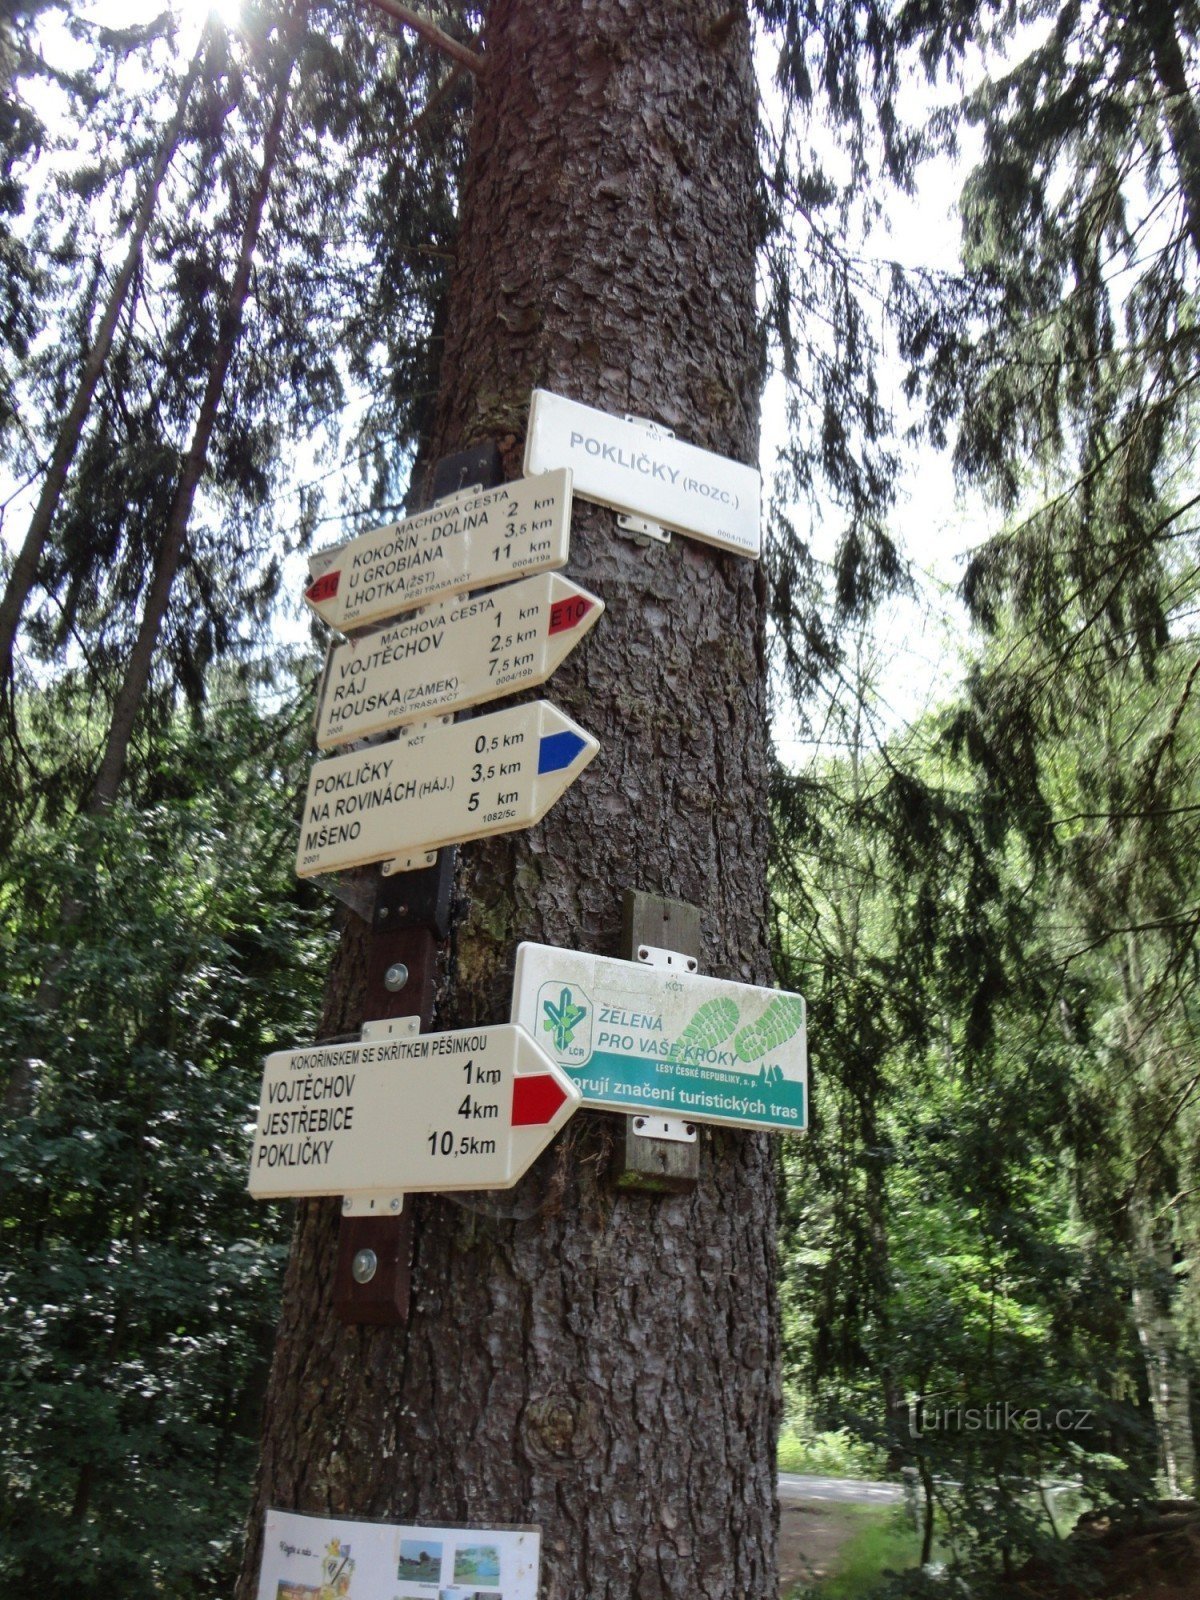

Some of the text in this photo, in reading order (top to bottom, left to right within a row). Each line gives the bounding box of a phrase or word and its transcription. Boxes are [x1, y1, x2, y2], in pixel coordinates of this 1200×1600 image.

[570, 431, 740, 510] POKLIČKY (ROZC.)
[464, 490, 508, 512] CESTA
[352, 532, 419, 569] KOKOŘÍN
[432, 511, 488, 542] DOLINA
[508, 501, 518, 517] 2
[534, 497, 554, 510] km
[349, 572, 360, 589] U
[363, 545, 443, 583] GROBIÁNA
[532, 518, 552, 531] km
[346, 577, 405, 609] LHOTKA
[492, 543, 511, 561] 11
[530, 540, 551, 553] km
[425, 579, 451, 592] TRASA
[381, 599, 495, 645] MÁCHOVA CESTA
[341, 606, 539, 679] VOJTĚCHOV 1 km
[333, 629, 537, 702] RÁJ 2,5 km
[496, 668, 533, 686] 0004/19b
[329, 653, 534, 723] HOUSKA (ZÁMEK) 7,5 km
[409, 698, 438, 710] TRASA
[441, 693, 459, 703] KČT
[407, 735, 425, 747] KČT
[314, 733, 524, 797] POKLIČKY 0,5 km
[310, 762, 521, 824] NA ROVINÁCH (HÁJ.) 3,5 km
[305, 791, 518, 851] MŠENO 5 km
[483, 809, 516, 823] 1082/5c
[598, 1008, 663, 1032] ZELENÁ
[290, 1034, 487, 1071] KOKOŘÍNSKEM SE SKŘÍTKEM PĚŠINKOU
[597, 1032, 739, 1066] PRO VAŠE KROKY
[269, 1073, 356, 1104] VOJTĚCHOV
[655, 1063, 673, 1074] LESY
[675, 1063, 699, 1078] ČESKÉ
[700, 1070, 742, 1086] REPUBLIKY,
[614, 1081, 676, 1101] značení
[679, 1090, 766, 1115] turistických
[770, 1103, 798, 1119] tras
[262, 1105, 354, 1136] JESTŘEBICE
[257, 1136, 334, 1168] POKLIČKY
